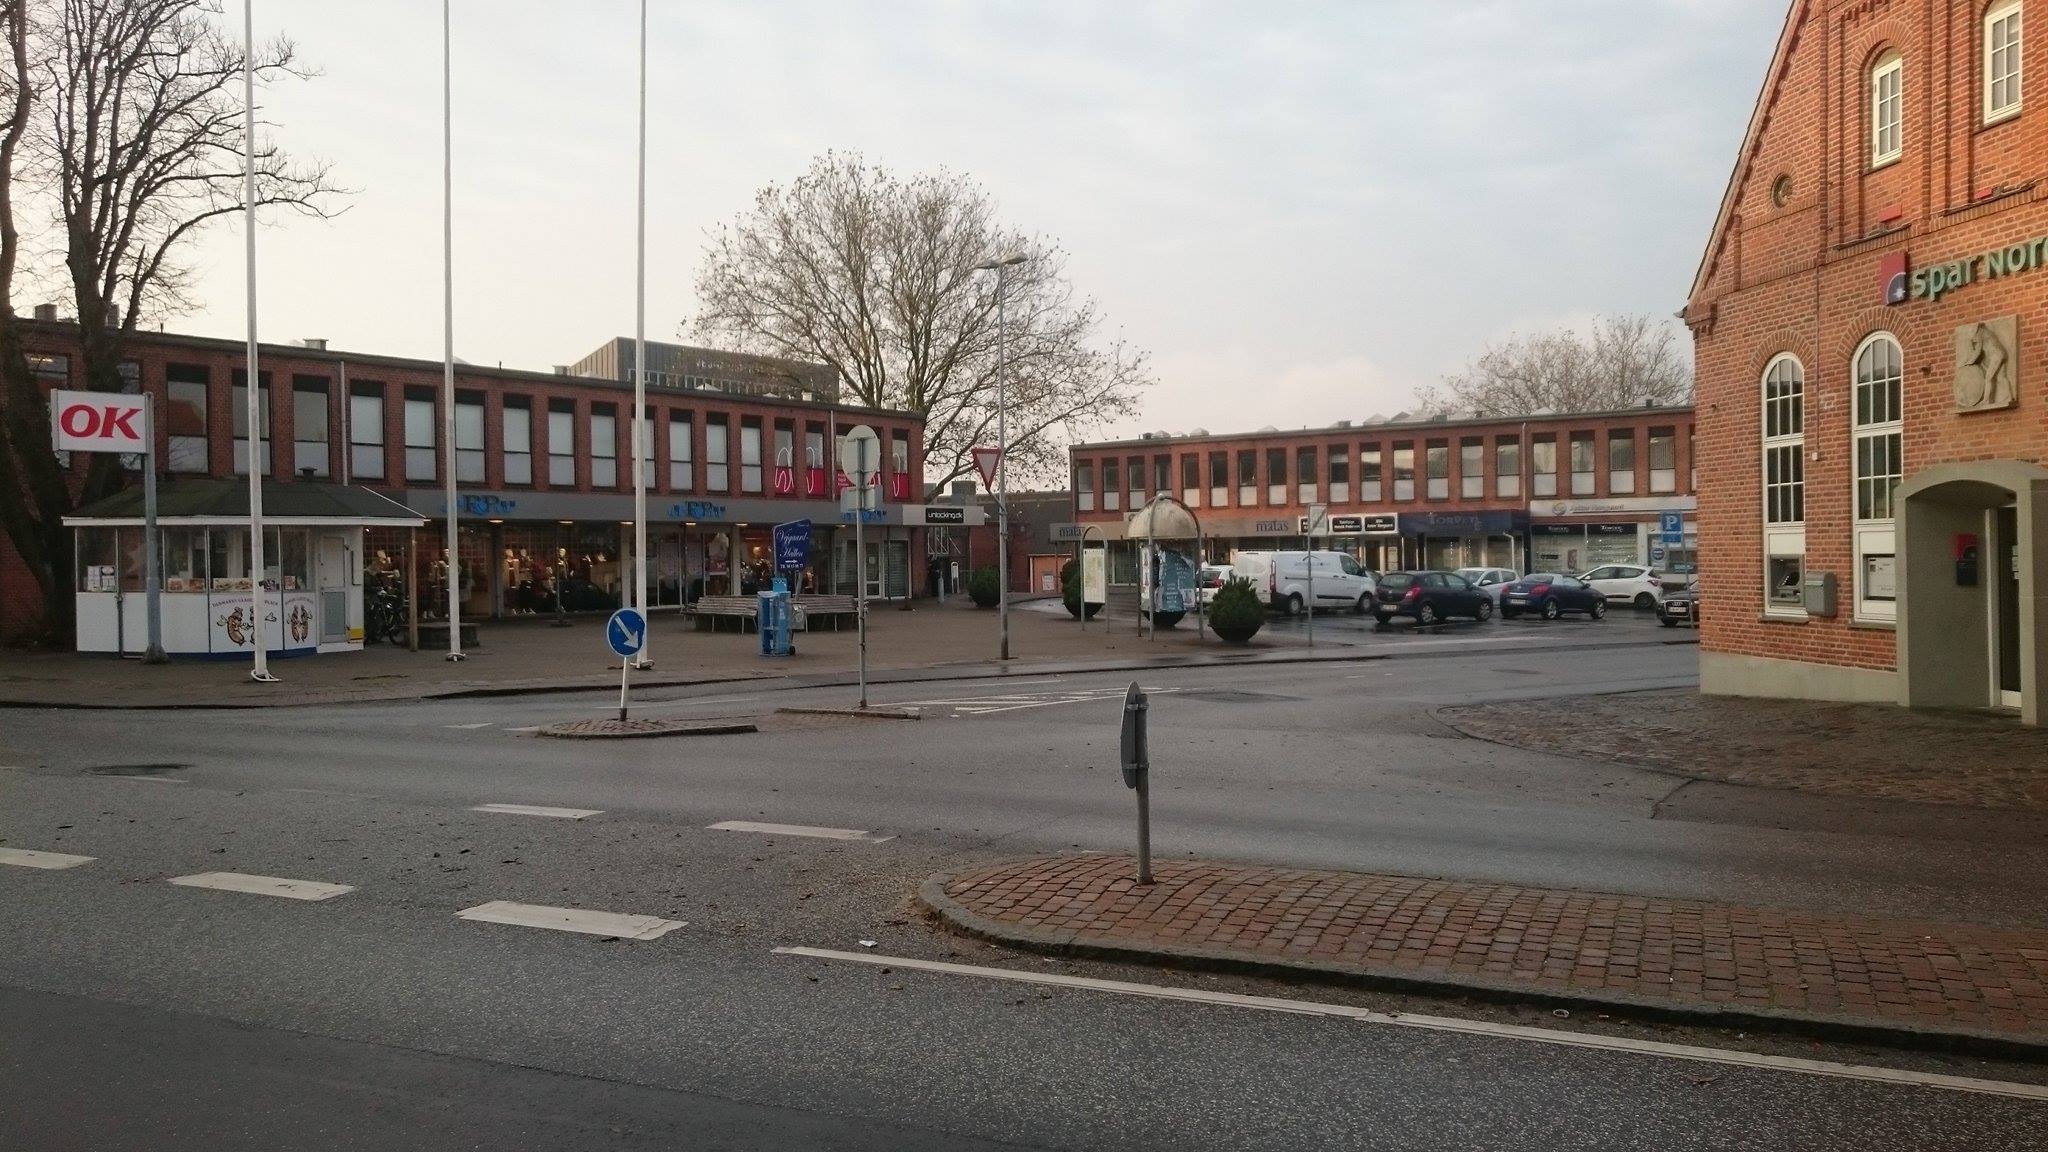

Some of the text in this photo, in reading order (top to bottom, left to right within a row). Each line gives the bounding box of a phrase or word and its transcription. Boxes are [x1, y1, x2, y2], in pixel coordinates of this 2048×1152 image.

[1911, 255, 1982, 302] spar
[61, 404, 143, 440] OK
[928, 511, 963, 519] unlocking.dk
[1665, 515, 1678, 530] P
[1256, 520, 1289, 532] matas
